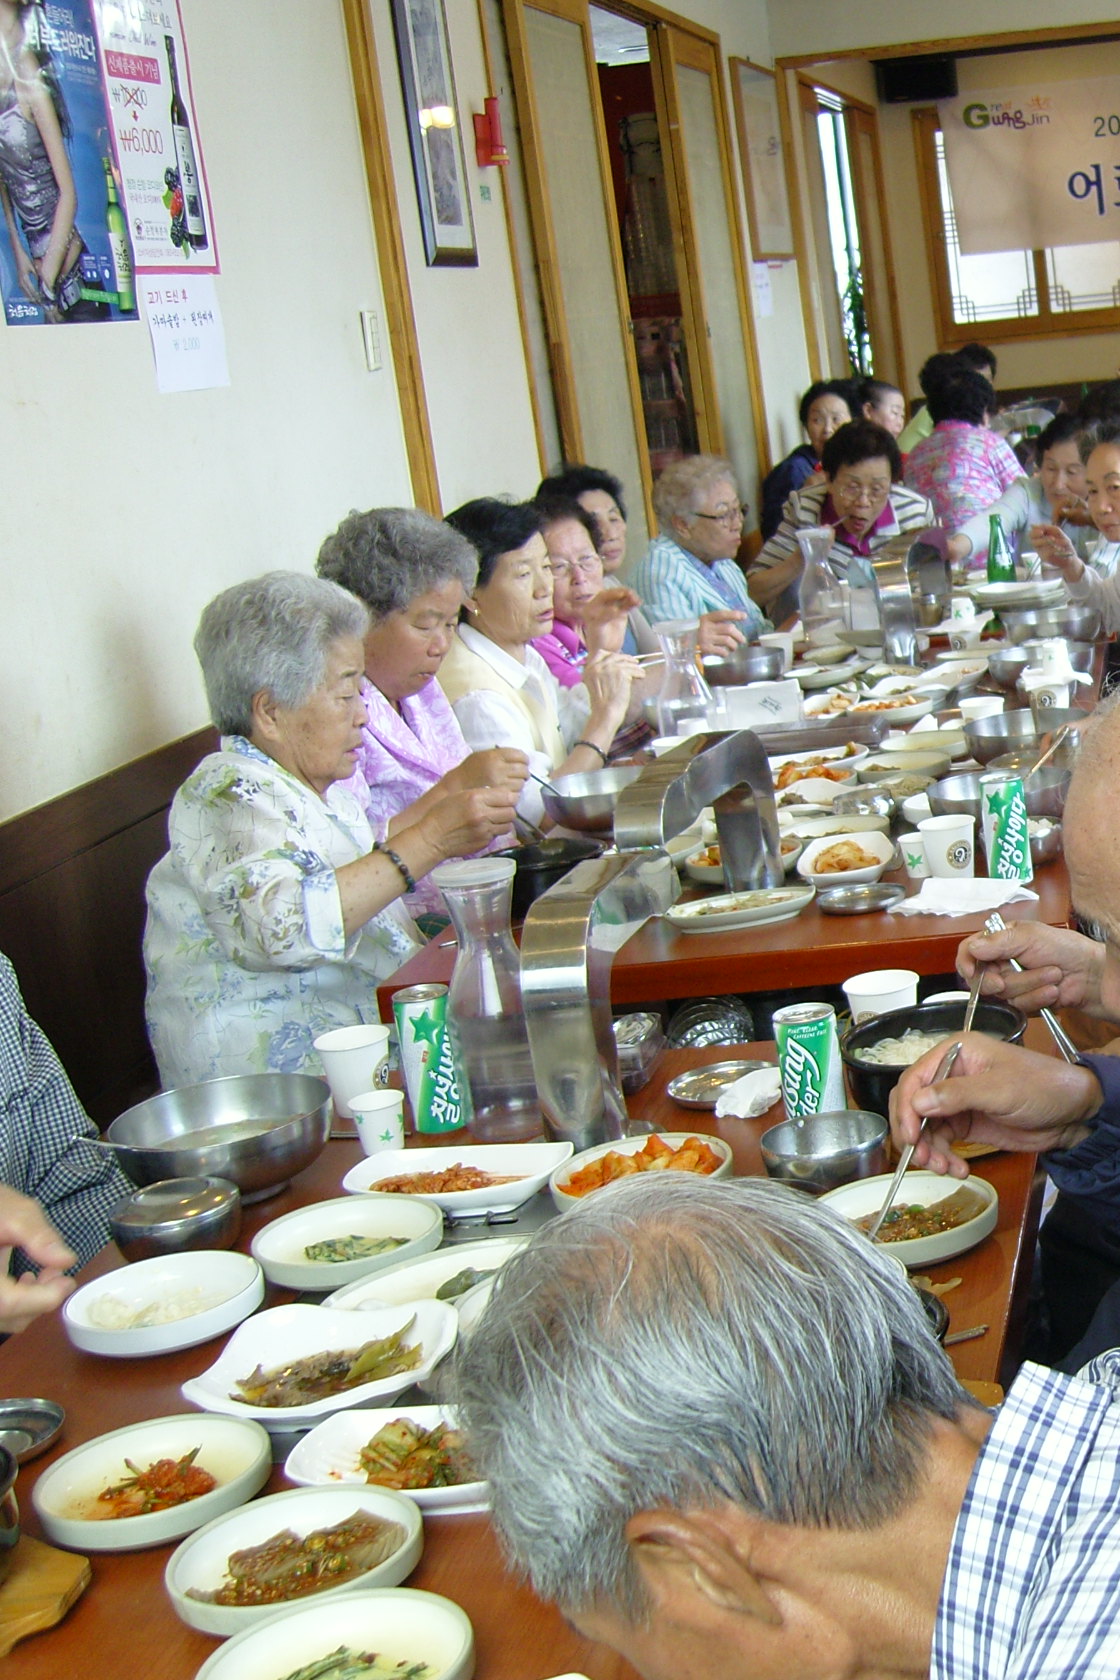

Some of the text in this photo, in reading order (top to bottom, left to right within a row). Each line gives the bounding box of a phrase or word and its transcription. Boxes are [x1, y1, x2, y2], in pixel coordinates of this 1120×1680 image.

[147, 290, 163, 304] 고기
[997, 792, 1026, 879] 칠성사이다
[430, 1023, 461, 1123] 칠성사이
